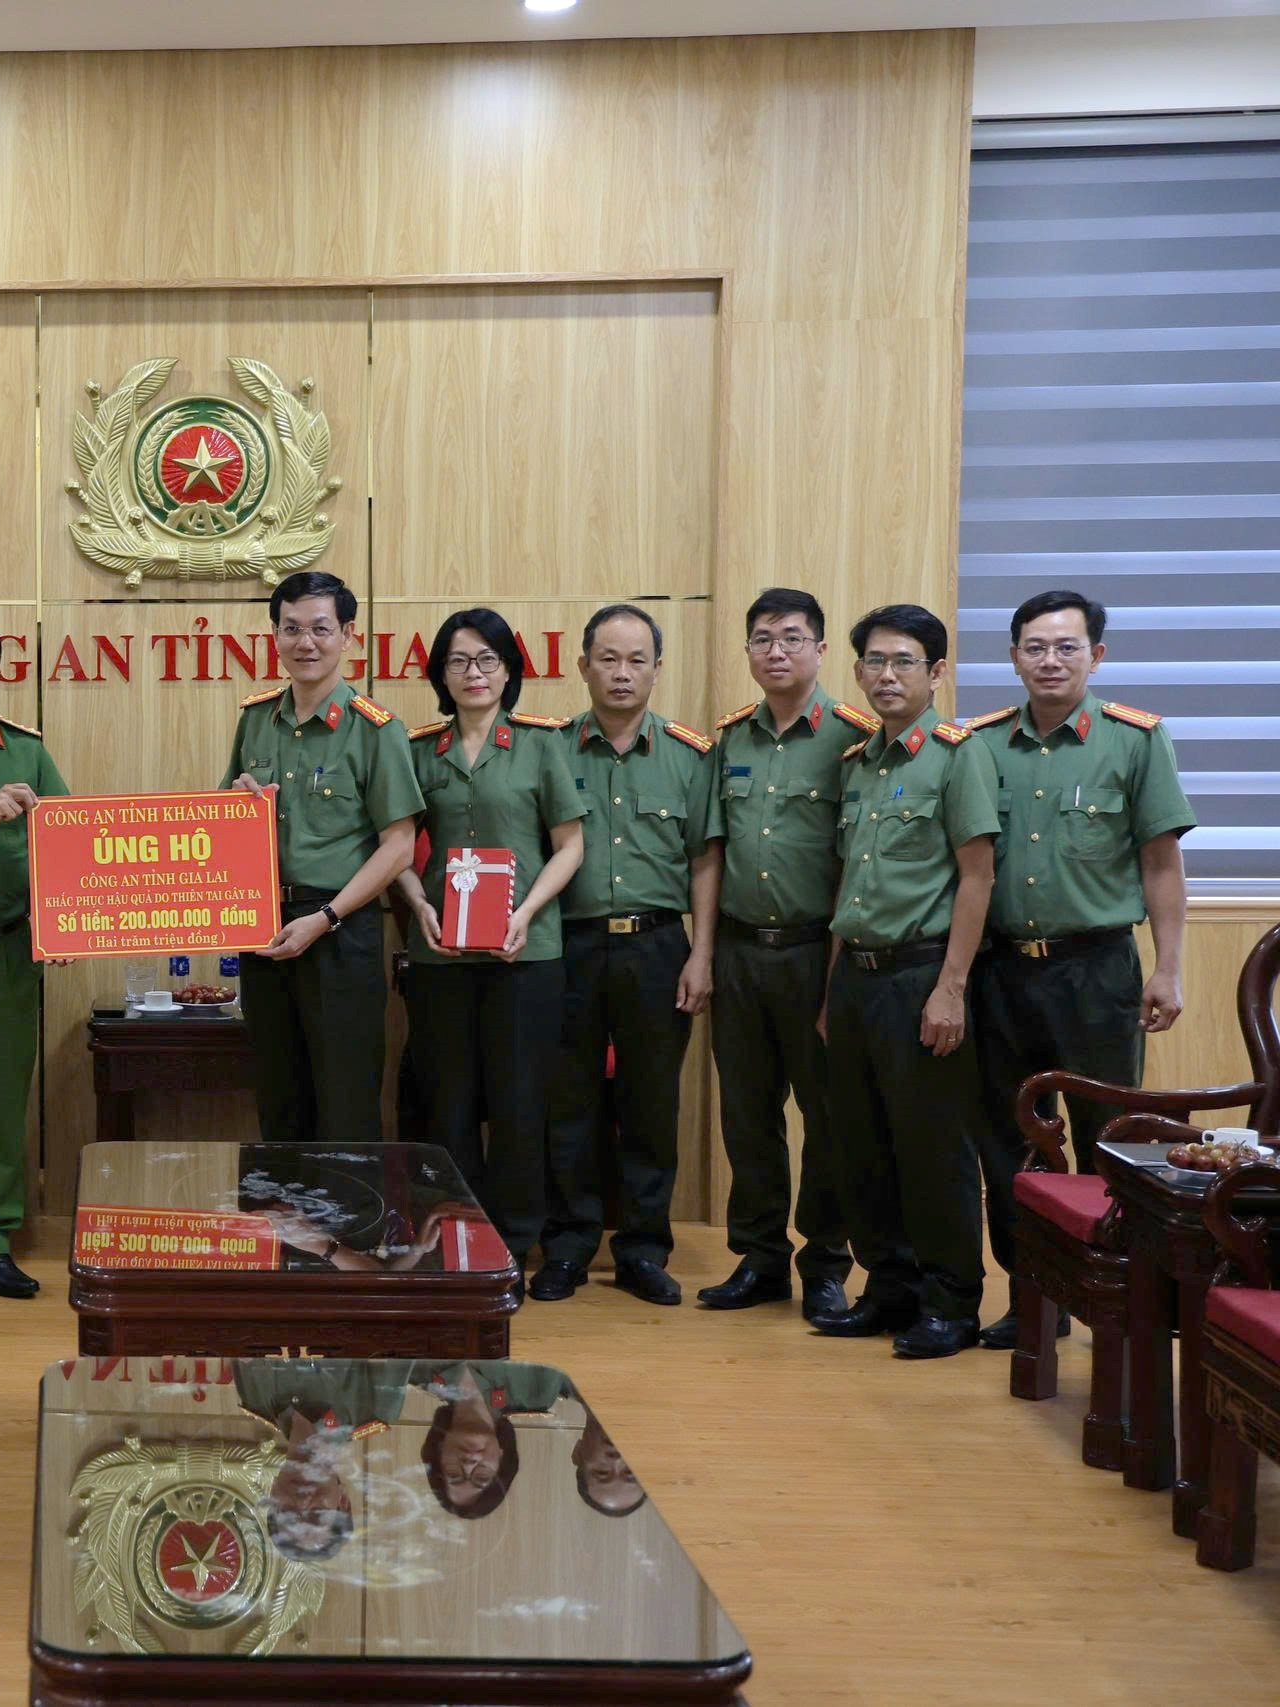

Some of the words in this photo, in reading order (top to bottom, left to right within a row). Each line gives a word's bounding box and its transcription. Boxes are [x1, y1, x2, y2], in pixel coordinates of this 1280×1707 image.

[48, 634, 134, 683] AN
[44, 806, 89, 826] CÔNG
[93, 811, 114, 824] AN
[119, 802, 158, 823] TỈNH
[164, 801, 218, 821] KHÁNH
[224, 800, 258, 819] HÒA
[93, 828, 160, 864] ỦNG
[170, 828, 212, 866] HỘ
[80, 872, 117, 888] CÔNG
[121, 875, 138, 886] AN
[142, 869, 176, 885] TỈNH
[179, 872, 203, 884] GIA
[206, 871, 228, 883] LAI
[46, 892, 73, 907] KHẮC
[76, 895, 104, 907] PHỤC
[107, 893, 128, 906] HẬU
[131, 890, 152, 905] QUẢ
[155, 892, 169, 903] DO
[171, 889, 203, 903] THIÊN
[206, 891, 222, 901] TAI
[224, 889, 245, 900] GÂY
[248, 890, 261, 899] RA
[58, 910, 77, 932] Số
[82, 908, 114, 931] tiền:
[119, 909, 211, 929] 200.000.000
[220, 904, 256, 927] đồng
[123, 934, 151, 947] trăm
[154, 931, 184, 949] triệu
